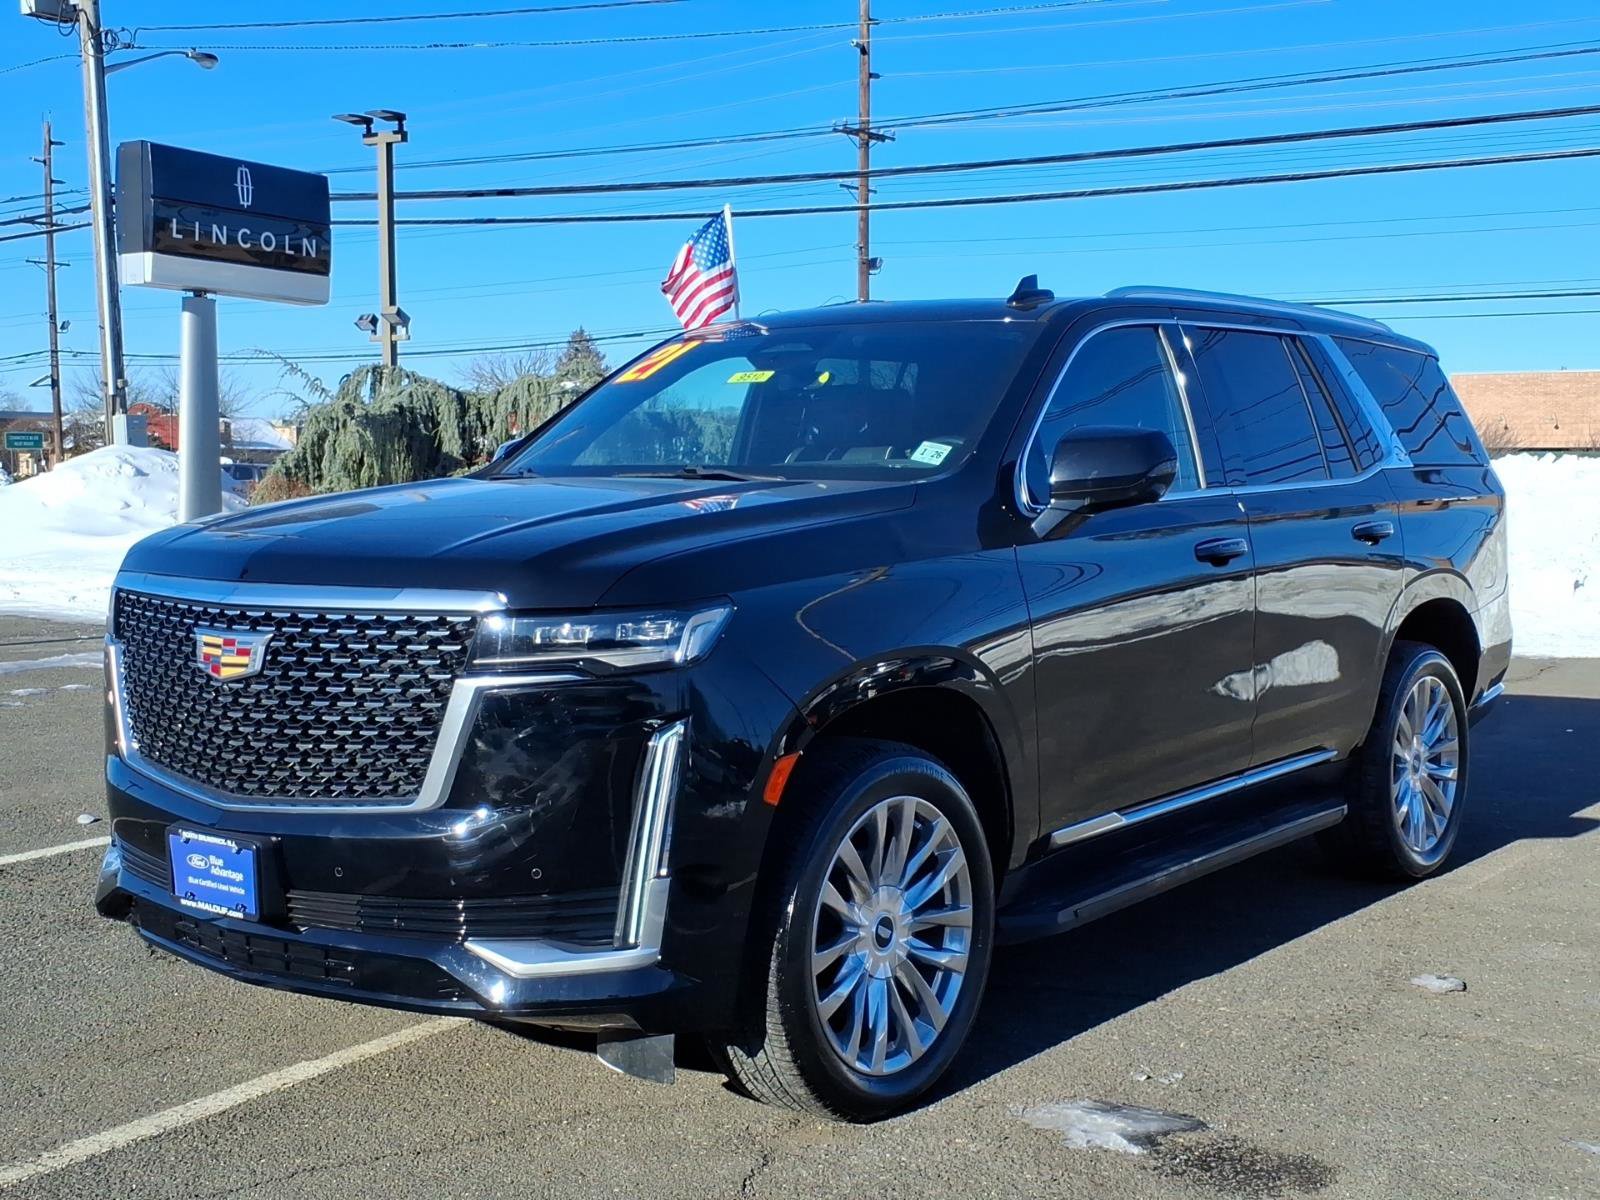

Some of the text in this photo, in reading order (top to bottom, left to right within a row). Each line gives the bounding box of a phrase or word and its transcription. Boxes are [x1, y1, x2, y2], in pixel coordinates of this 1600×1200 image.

[171, 218, 317, 258] LINCOLN
[190, 855, 207, 868] Ford
[208, 855, 224, 867] Blue
[211, 866, 243, 881] Advantage
